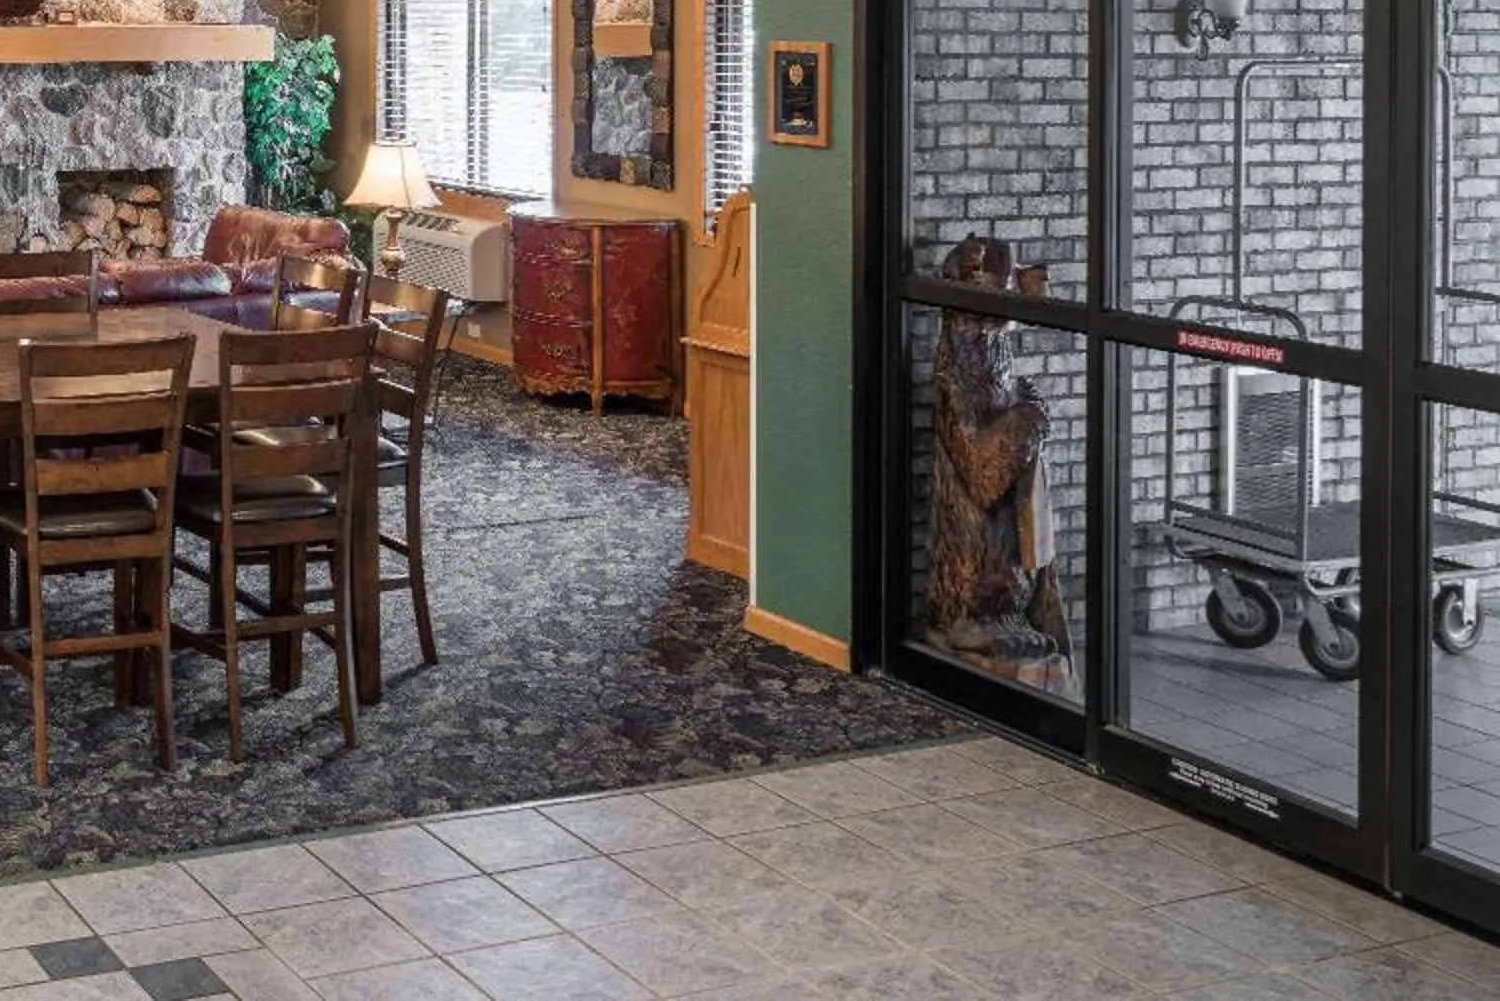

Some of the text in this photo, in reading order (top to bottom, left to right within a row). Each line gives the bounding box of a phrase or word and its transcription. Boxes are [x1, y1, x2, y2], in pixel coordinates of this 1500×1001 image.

[1188, 333, 1229, 352] EMERGENCY
[1231, 341, 1250, 357] PUSH
[1251, 345, 1261, 359] TO
[1262, 347, 1283, 363] OPEN
